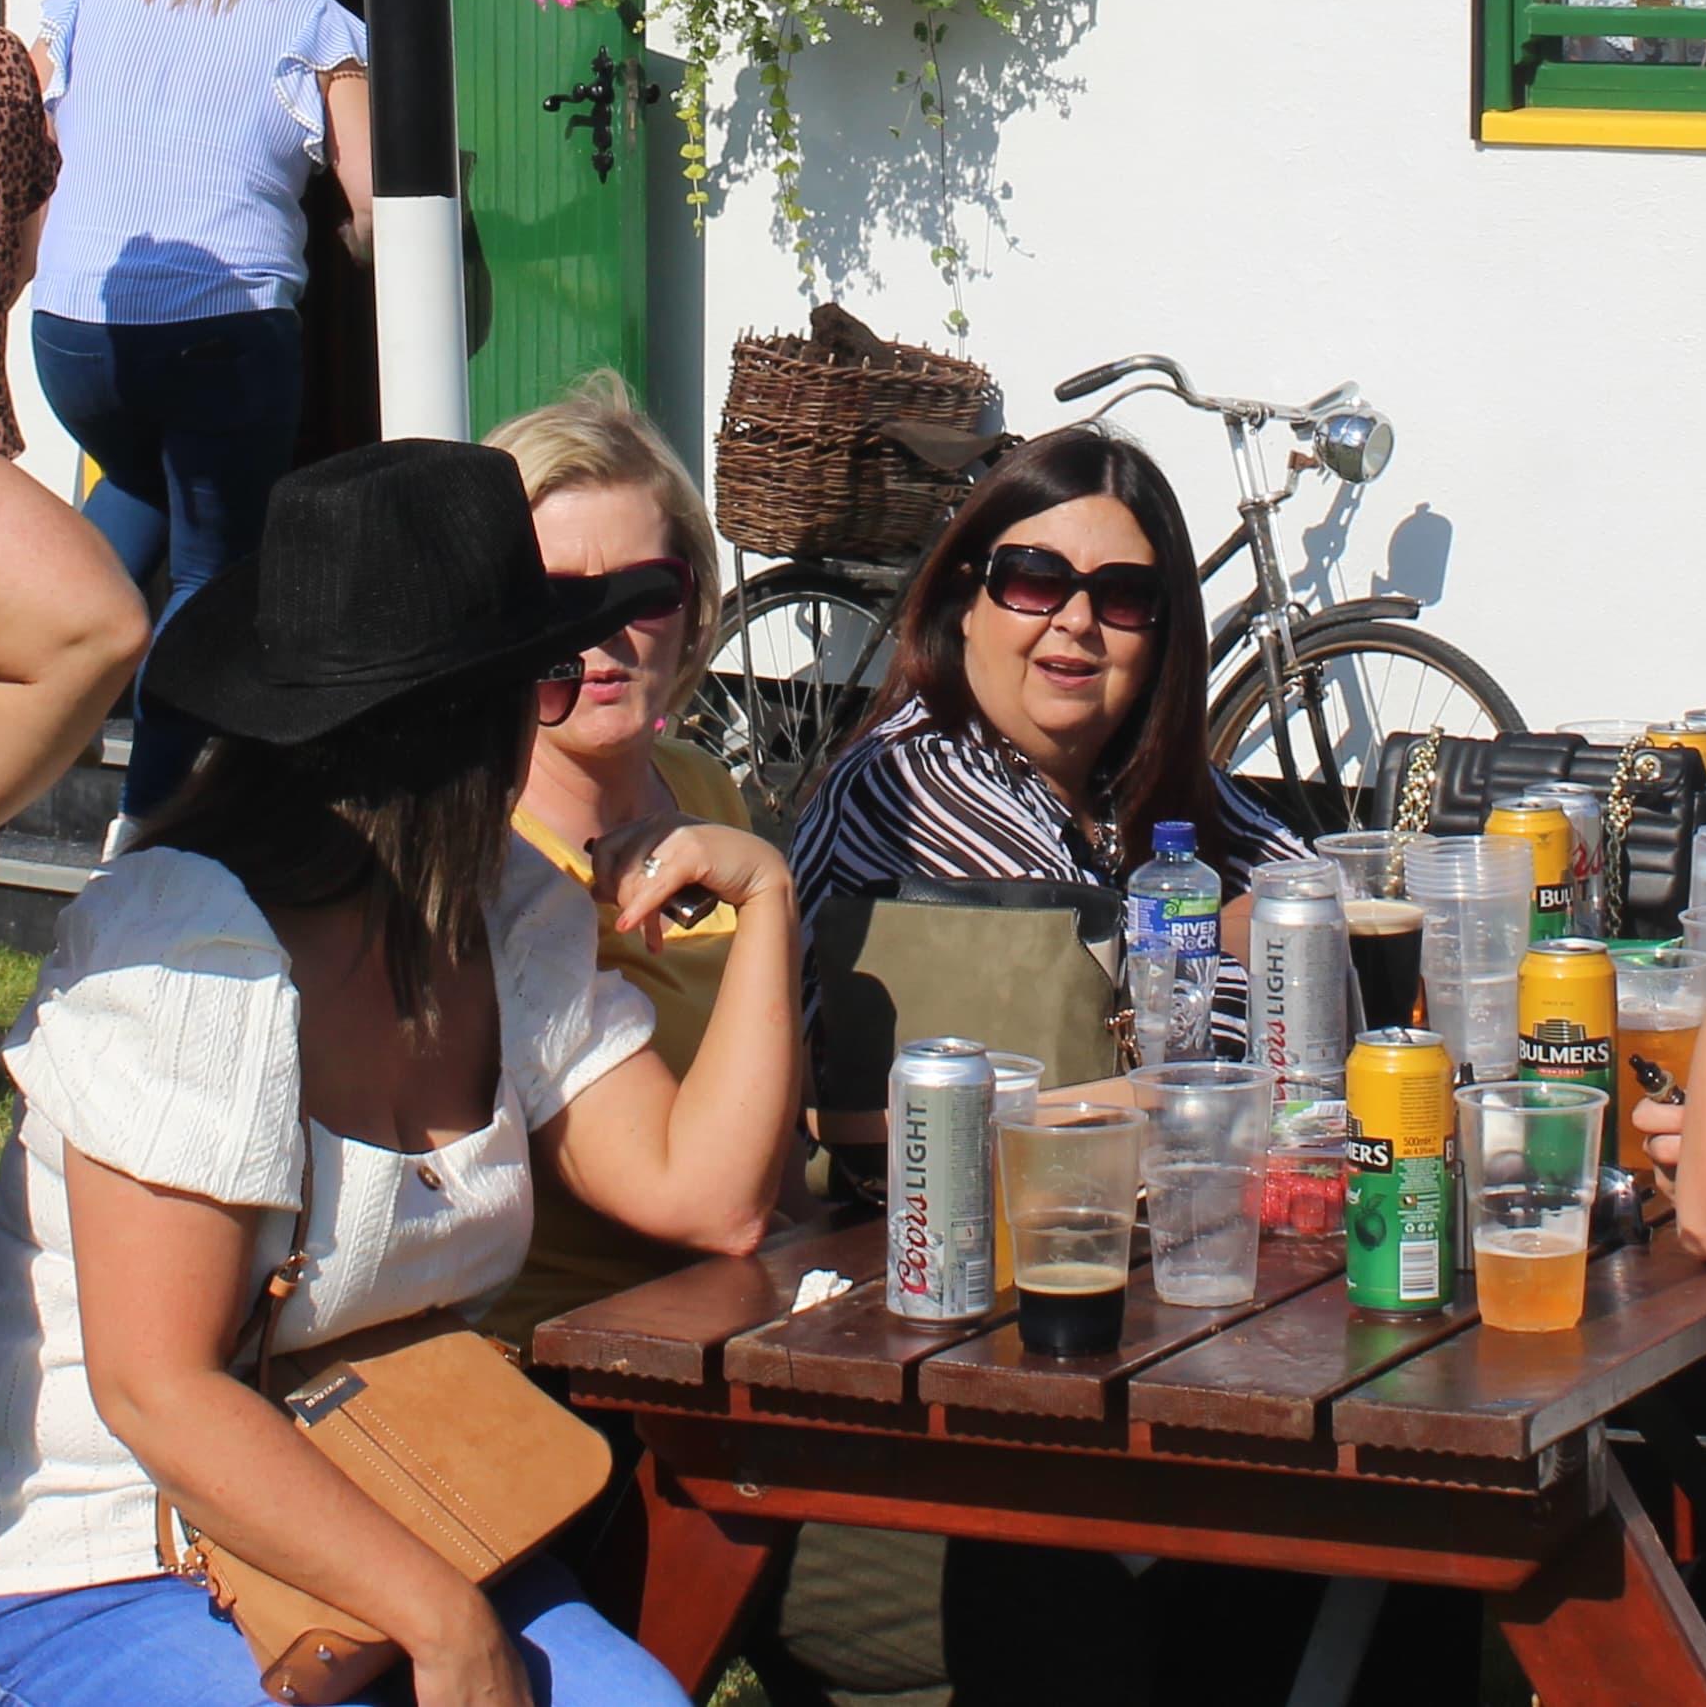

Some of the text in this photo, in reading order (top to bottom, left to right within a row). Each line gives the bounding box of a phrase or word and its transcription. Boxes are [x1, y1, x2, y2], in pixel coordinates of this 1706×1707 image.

[1171, 920, 1217, 936] RIVER
[1267, 939, 1284, 1015] LIGHT
[1519, 1039, 1610, 1063] BULMERS
[896, 1102, 928, 1295] Coors LIGHT
